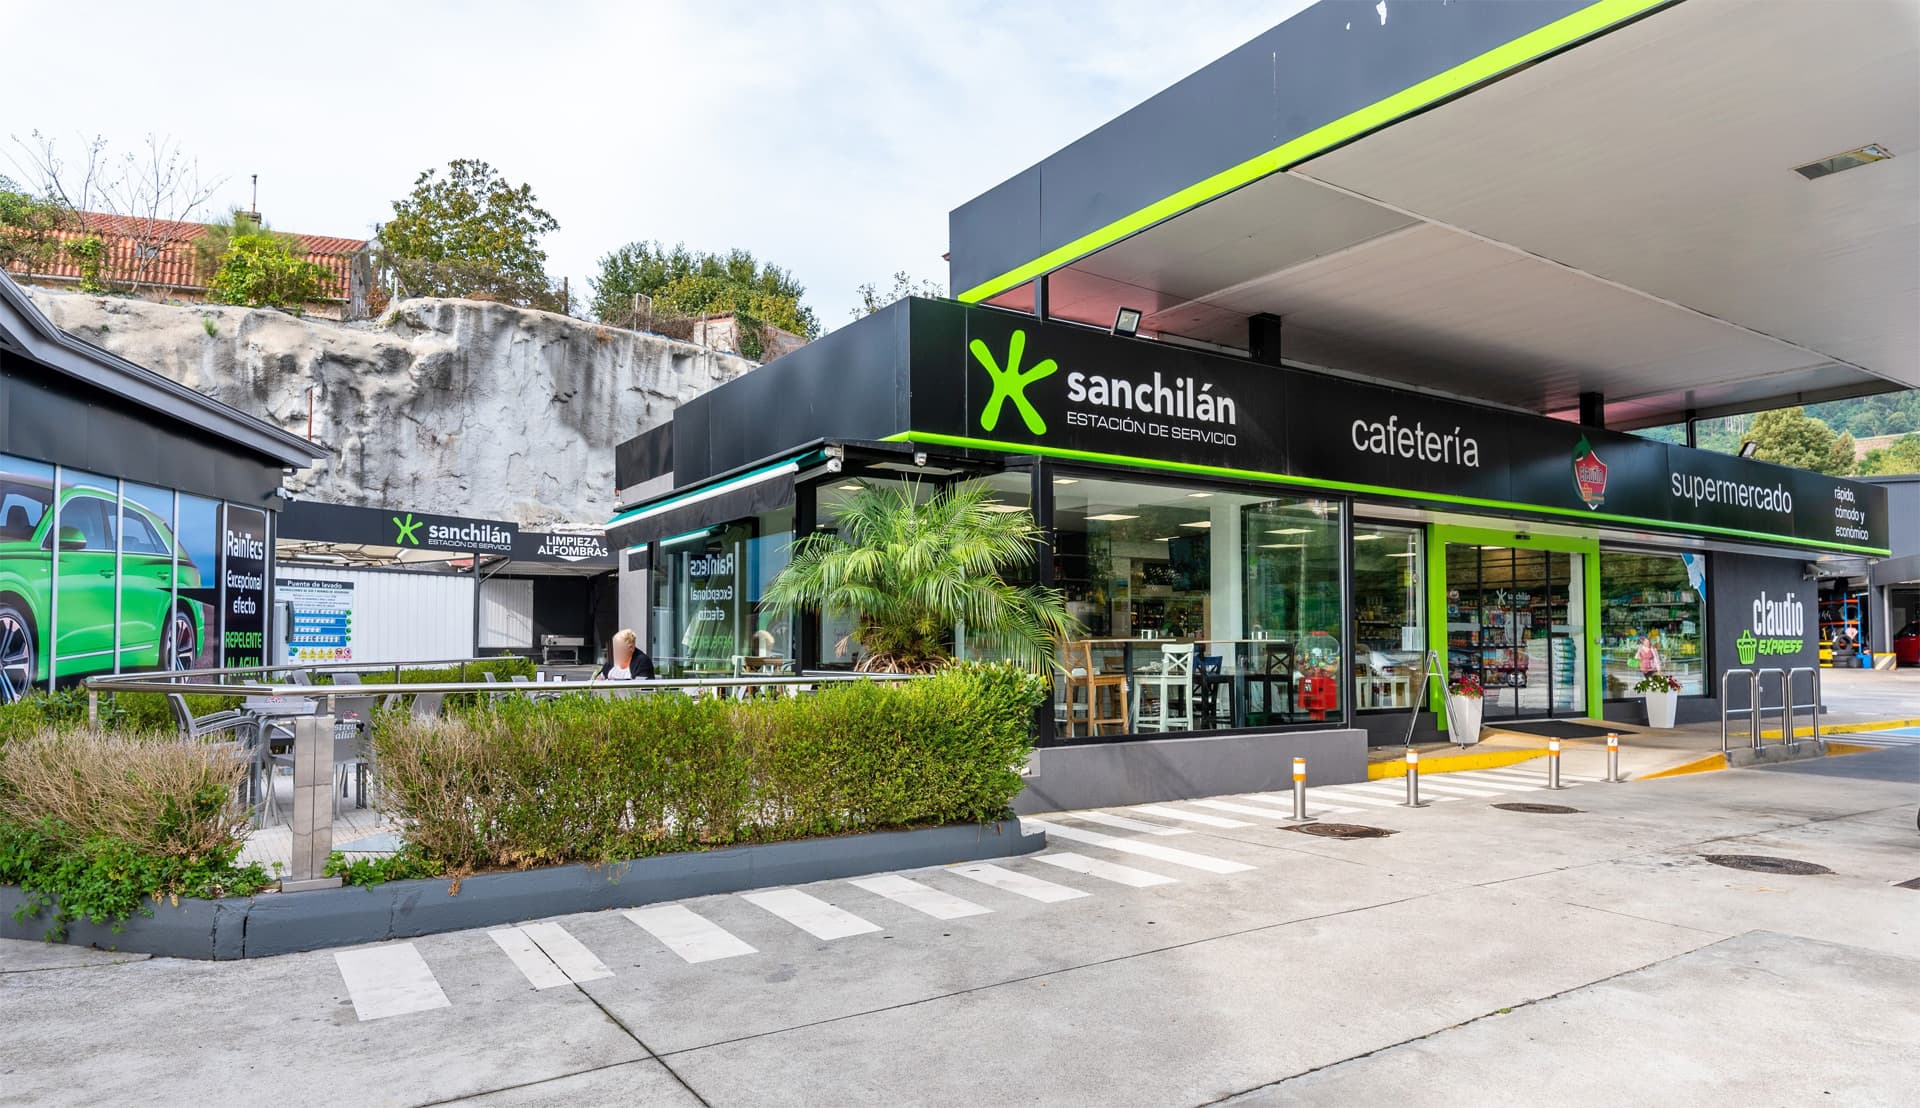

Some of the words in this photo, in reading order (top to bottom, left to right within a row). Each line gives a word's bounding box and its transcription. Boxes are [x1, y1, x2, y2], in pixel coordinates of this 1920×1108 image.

[1067, 371, 1236, 425] sanchilán
[1067, 411, 1146, 435] ESTACIÓN
[1149, 423, 1169, 438] DE
[1171, 426, 1237, 446] SERVICIO
[1351, 415, 1480, 468] cafetería
[1671, 472, 1792, 514] supermercado
[1834, 486, 1856, 504] rápido,
[1835, 505, 1860, 521] cómodo
[1860, 511, 1865, 525] y
[429, 523, 511, 544] sanchilán
[546, 535, 600, 547] LIMPIEZA
[1835, 525, 1869, 541] económico
[227, 530, 264, 560] RainTecs
[428, 538, 467, 549] ESTACIÓN
[478, 543, 512, 551] SERVICIO
[537, 545, 609, 557] ALFOMBRAS
[227, 569, 263, 592] Excepcional
[287, 580, 311, 588] Puente
[321, 581, 343, 589] lavado
[233, 596, 256, 615] efecto
[1752, 591, 1804, 636] claudio
[225, 631, 263, 649] REPELENTE
[1758, 637, 1804, 655] EXPRESS
